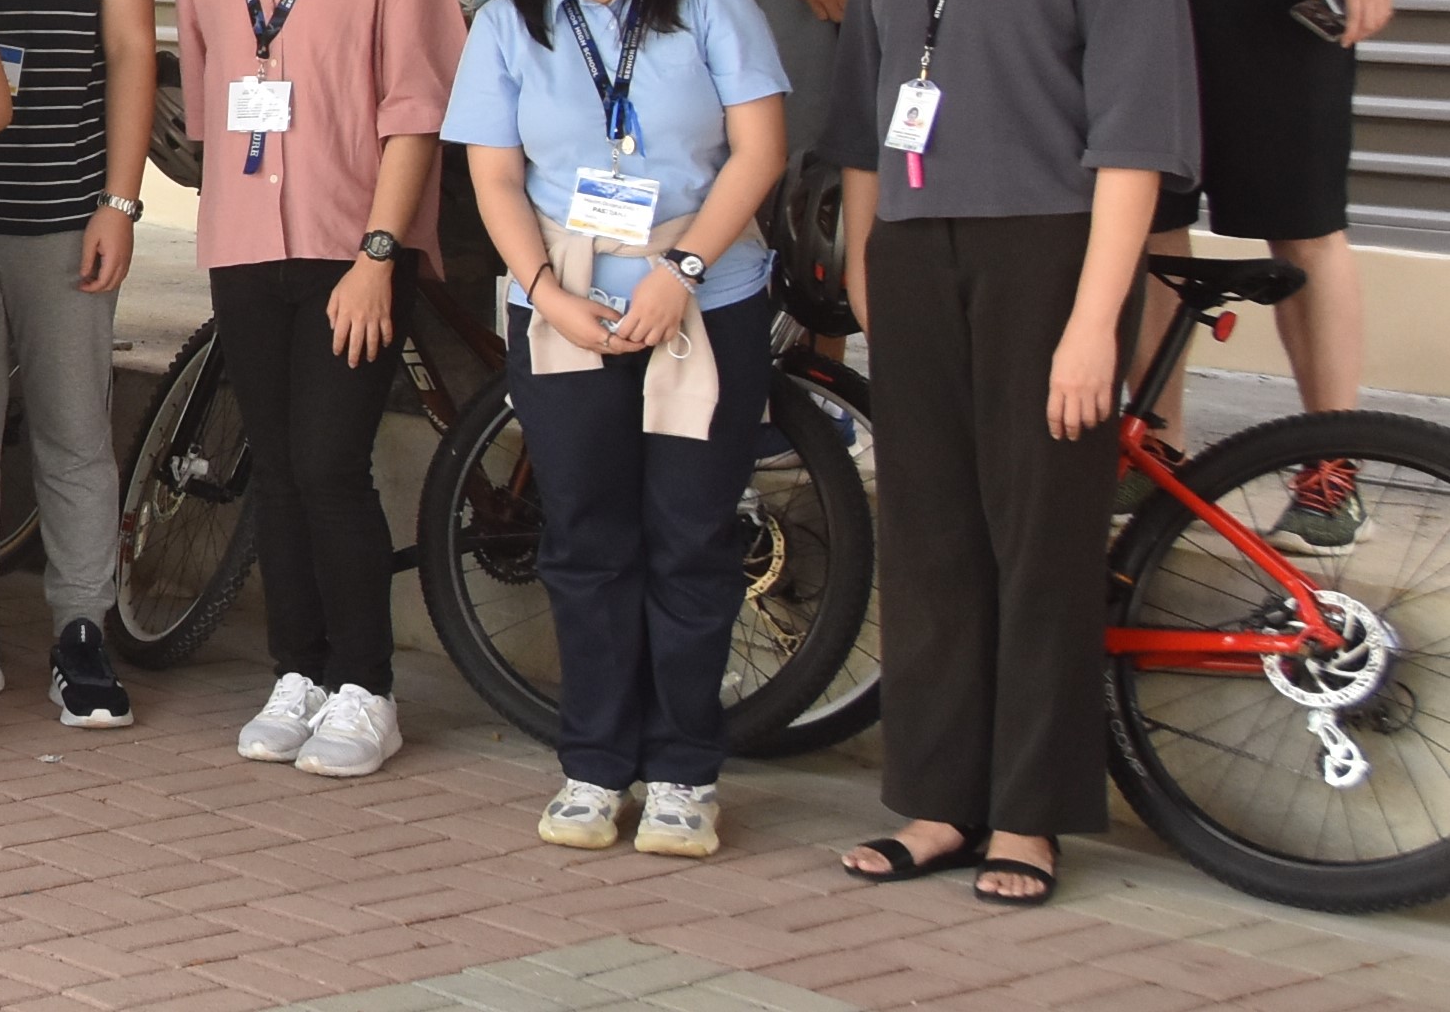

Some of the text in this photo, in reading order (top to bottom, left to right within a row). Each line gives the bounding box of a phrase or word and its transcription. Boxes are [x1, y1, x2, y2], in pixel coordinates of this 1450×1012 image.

[574, 26, 587, 47] HIGH
[582, 46, 599, 78] SCHOOL
[623, 49, 635, 80] SENIOR
[630, 27, 641, 48] HIGH
